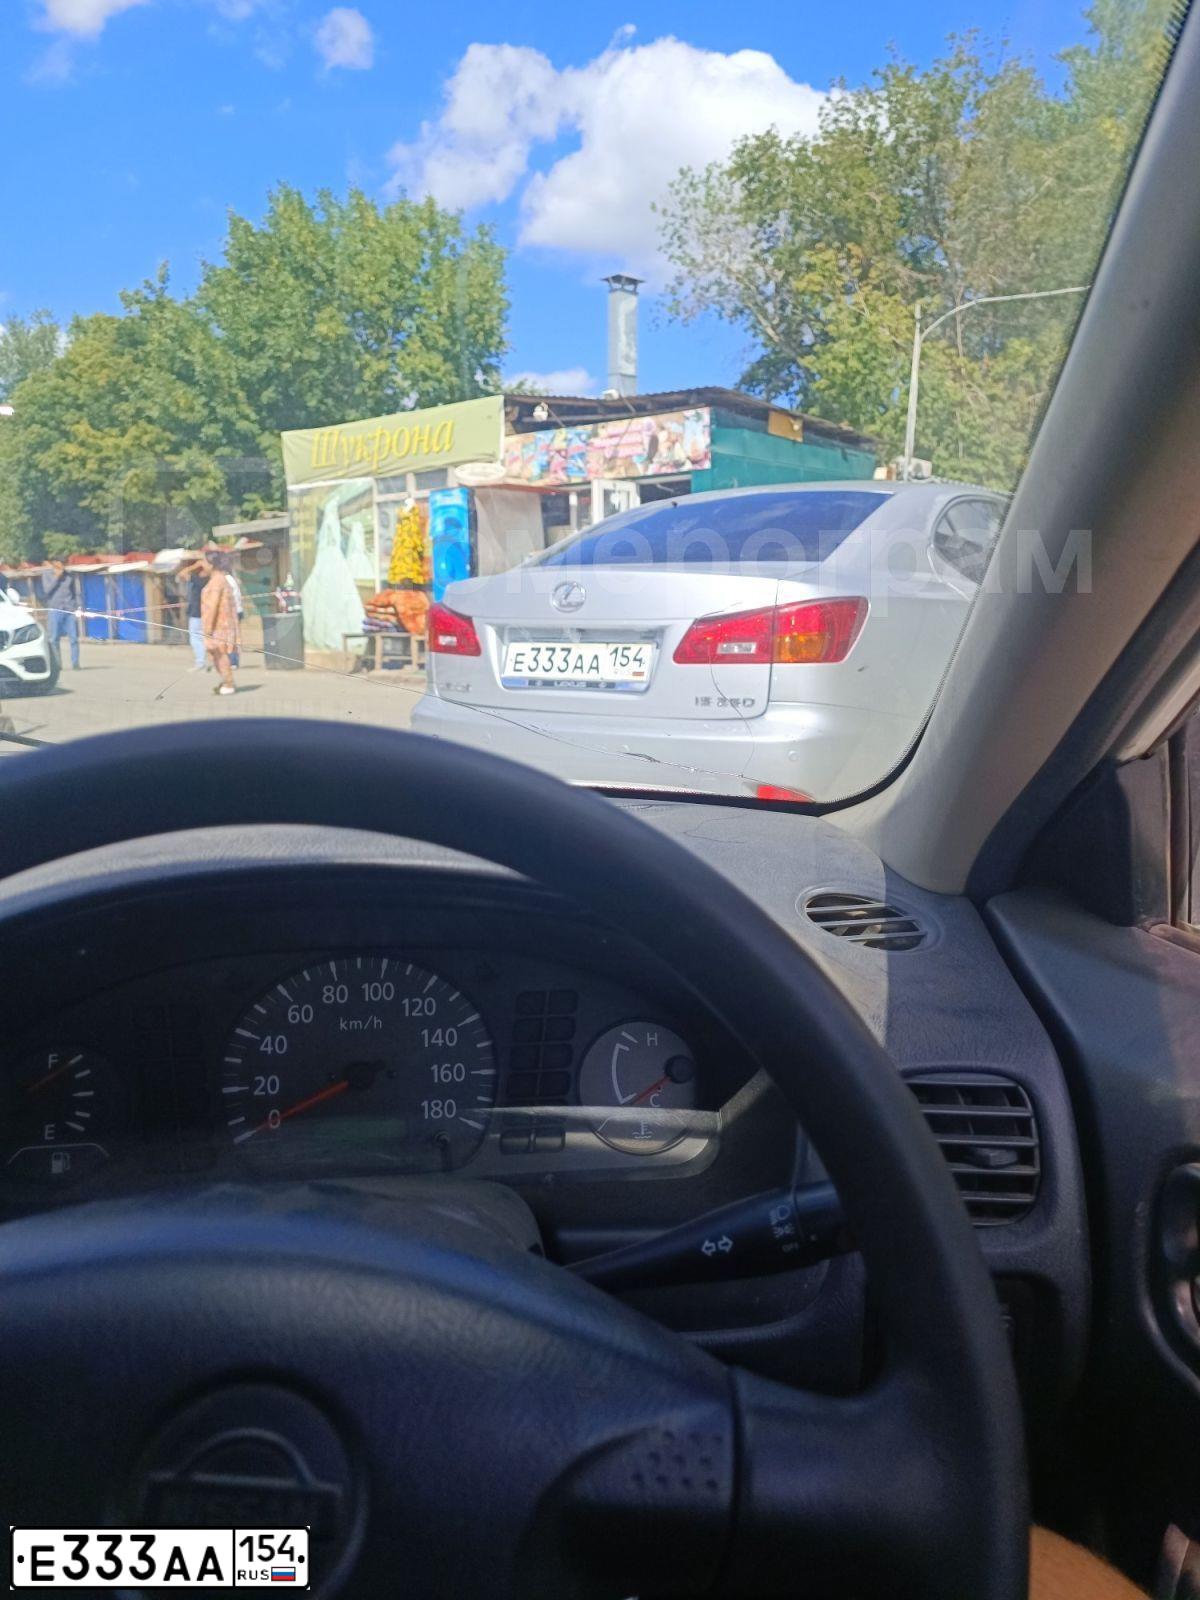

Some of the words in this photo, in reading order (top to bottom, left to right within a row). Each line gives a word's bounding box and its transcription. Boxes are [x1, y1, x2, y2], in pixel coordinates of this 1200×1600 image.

[311, 419, 454, 476] Шукрона
[609, 647, 644, 668] 154
[323, 985, 348, 1003] 80
[362, 982, 395, 1001] 100
[288, 1004, 314, 1023] 60
[402, 998, 436, 1017] 120
[340, 1015, 383, 1031] km/h
[260, 1035, 288, 1055] 40
[422, 1028, 458, 1047] 140
[646, 1032, 658, 1047] H
[48, 1053, 59, 1069] F
[431, 1063, 466, 1083] 160
[254, 1075, 280, 1095] 20
[421, 1099, 457, 1119] 180
[268, 1109, 281, 1130] 0
[44, 1124, 55, 1140] E
